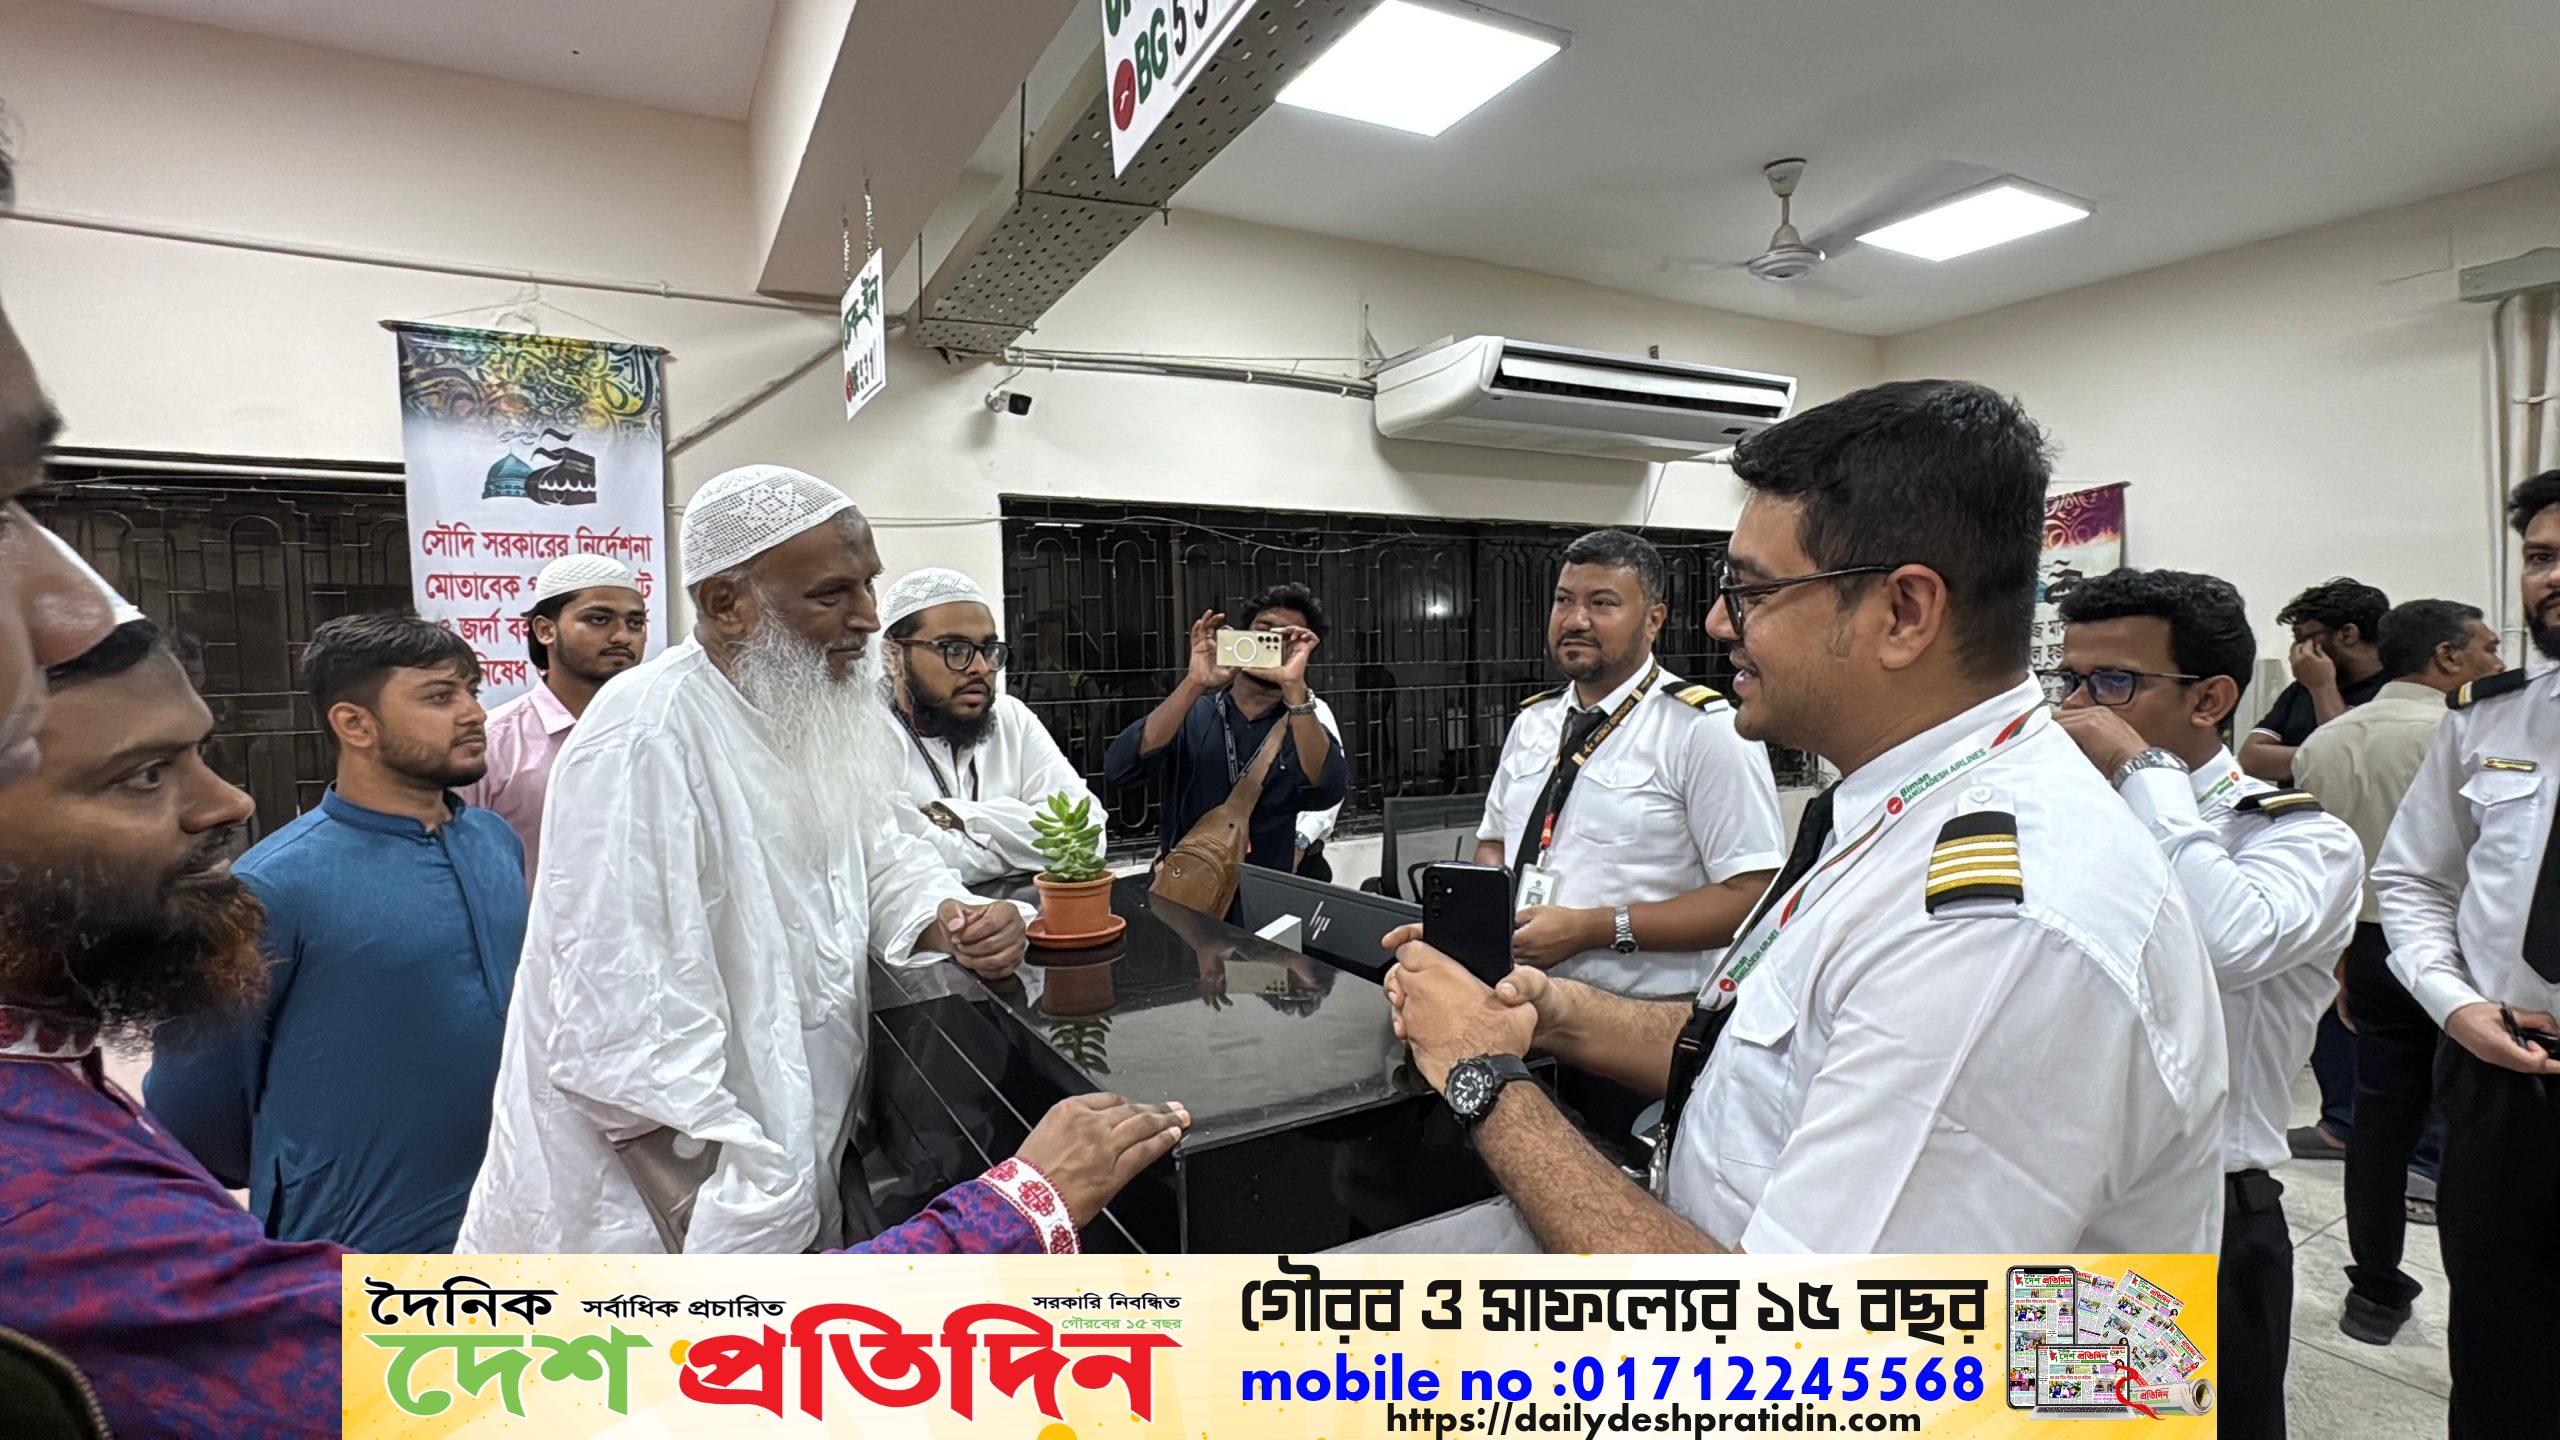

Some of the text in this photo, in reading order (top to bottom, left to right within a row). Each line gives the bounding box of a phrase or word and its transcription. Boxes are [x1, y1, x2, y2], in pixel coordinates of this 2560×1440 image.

[422, 520, 476, 558] সৌদি
[482, 531, 570, 560] সরকারের
[425, 571, 521, 602] মোতাবেক
[457, 608, 501, 645] জর্দা
[1899, 772, 1932, 797] Biman
[1902, 748, 1987, 805] BANGLADESH AIRLINES
